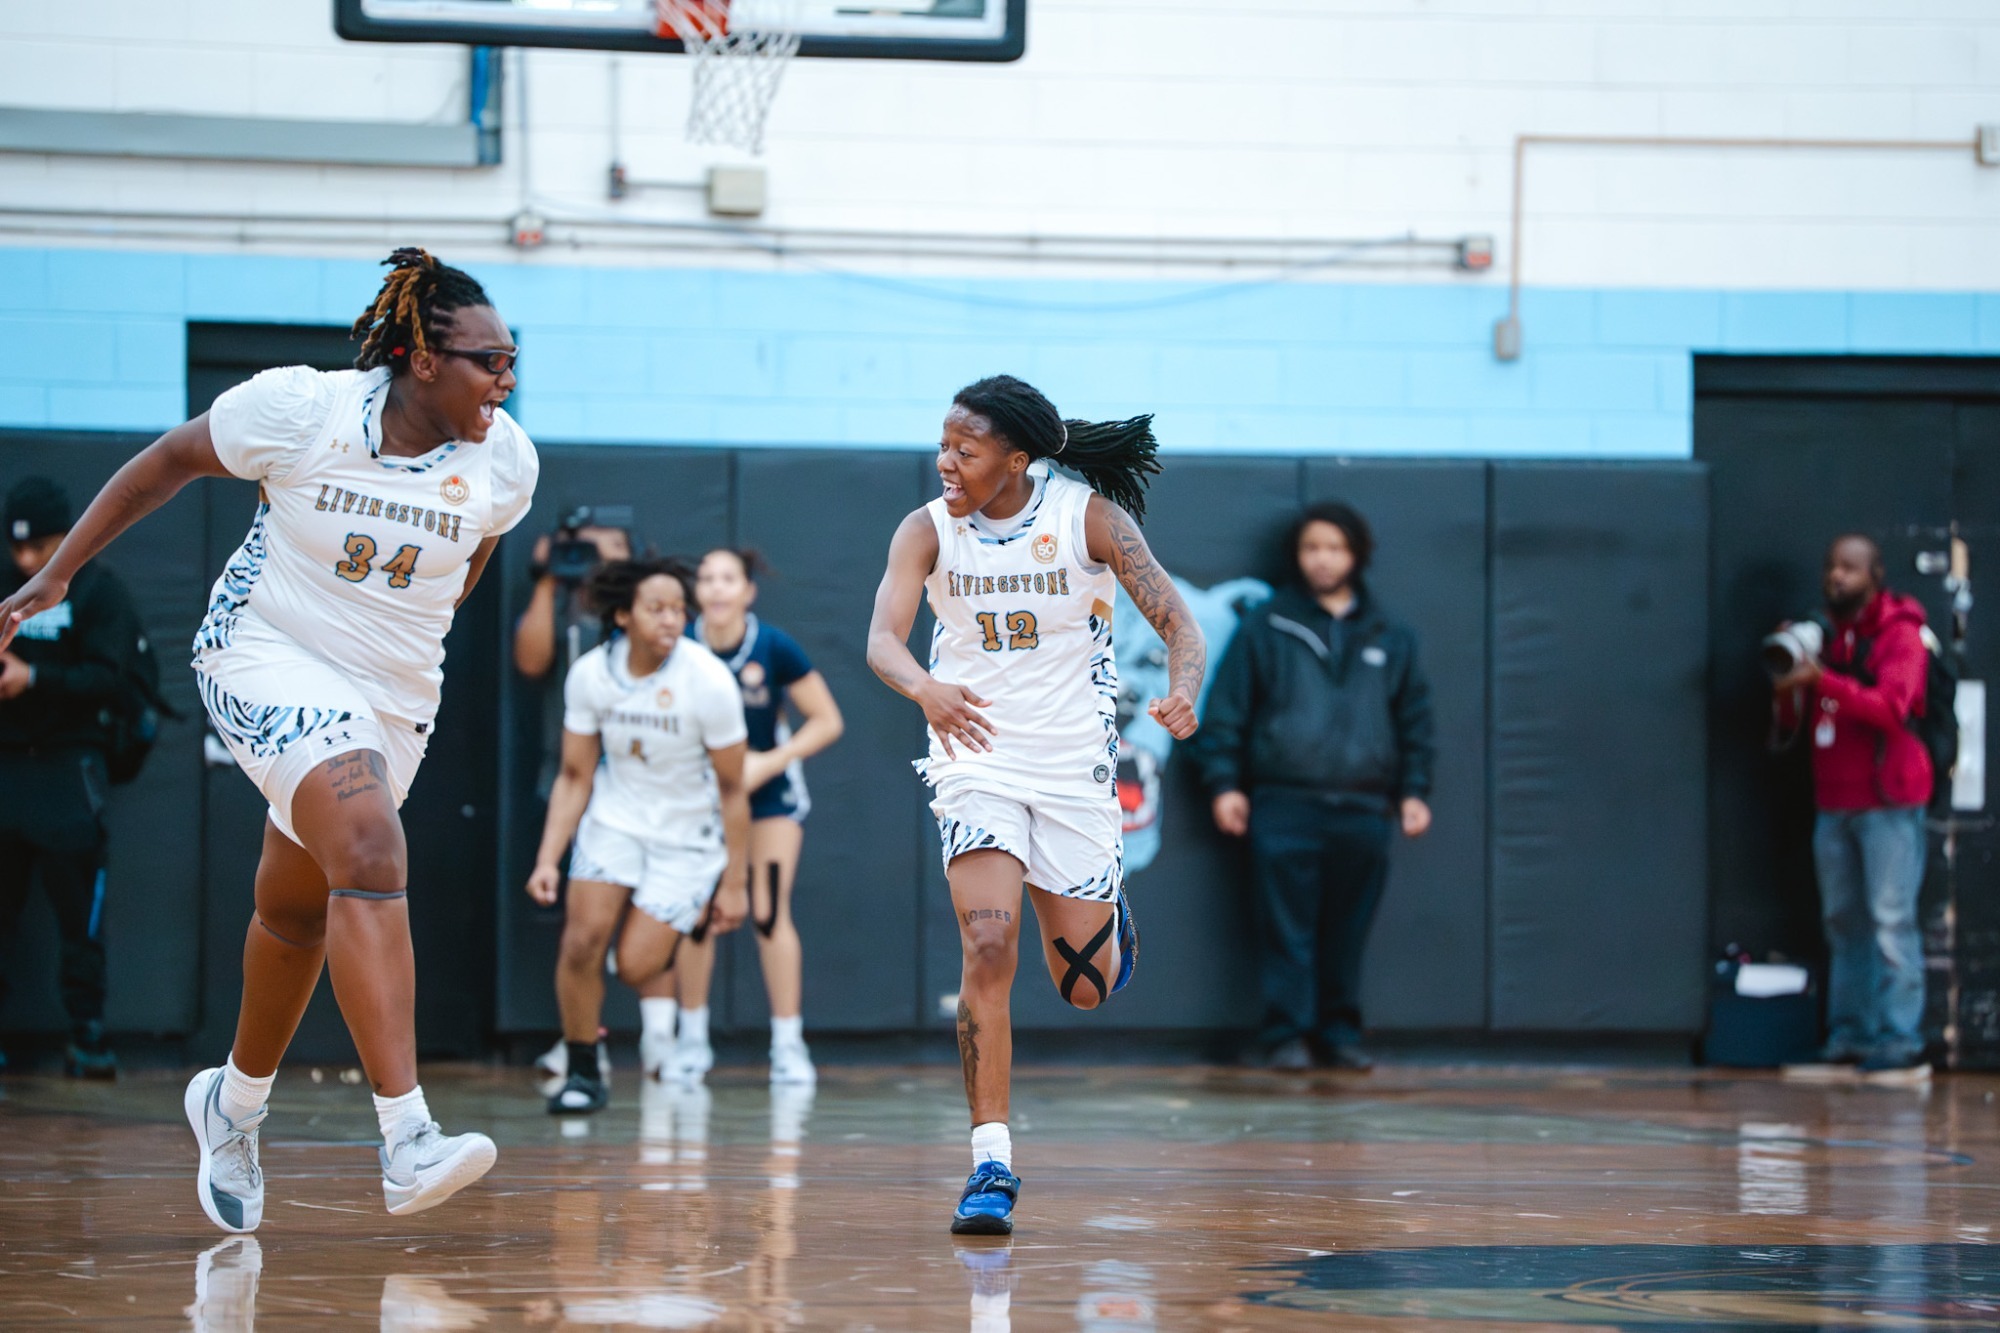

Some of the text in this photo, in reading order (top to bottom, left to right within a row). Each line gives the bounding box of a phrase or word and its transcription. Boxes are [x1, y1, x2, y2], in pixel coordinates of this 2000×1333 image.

[446, 485, 464, 497] 50
[315, 484, 462, 542] LIVINGSTONE
[336, 533, 422, 588] 34
[1037, 544, 1055, 556] 50
[948, 568, 1069, 596] LIVINGSTONE
[976, 611, 1039, 651] 12
